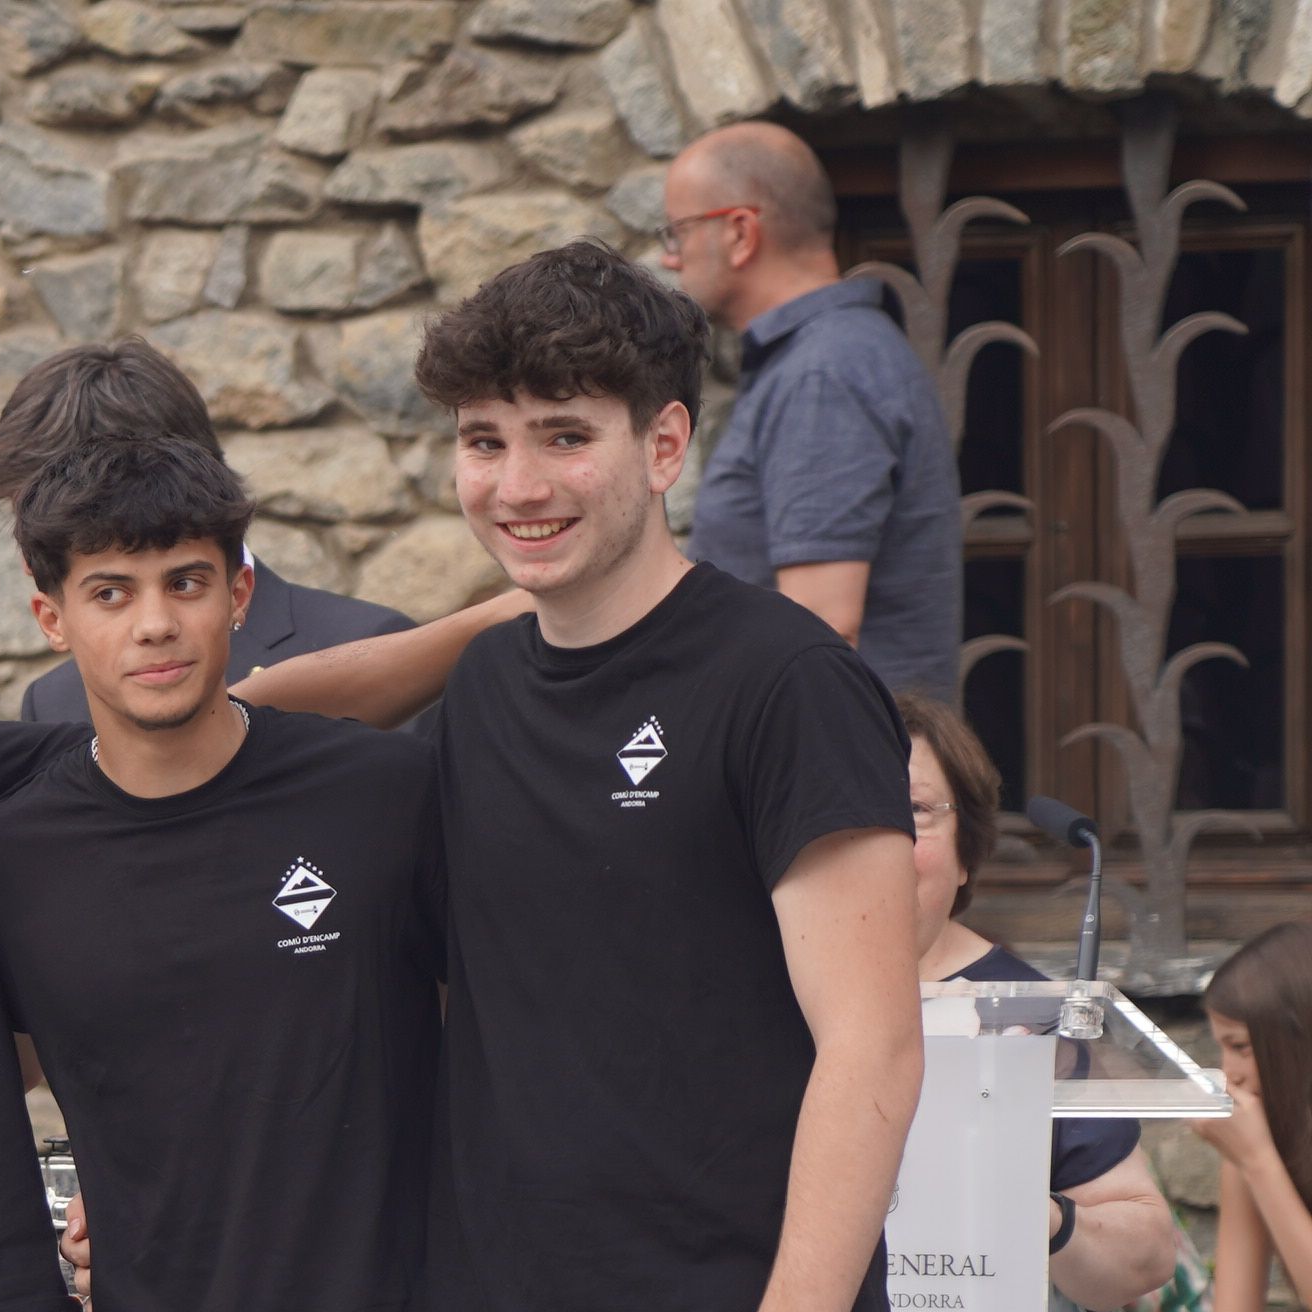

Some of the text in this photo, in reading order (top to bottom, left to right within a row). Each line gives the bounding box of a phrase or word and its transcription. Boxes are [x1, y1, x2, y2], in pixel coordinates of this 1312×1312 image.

[278, 931, 340, 948] COMÚ D'ENCAMP
[294, 944, 326, 953] ANDORRA
[886, 1252, 997, 1278] ENERAL
[887, 1292, 966, 1310] NDORRA
